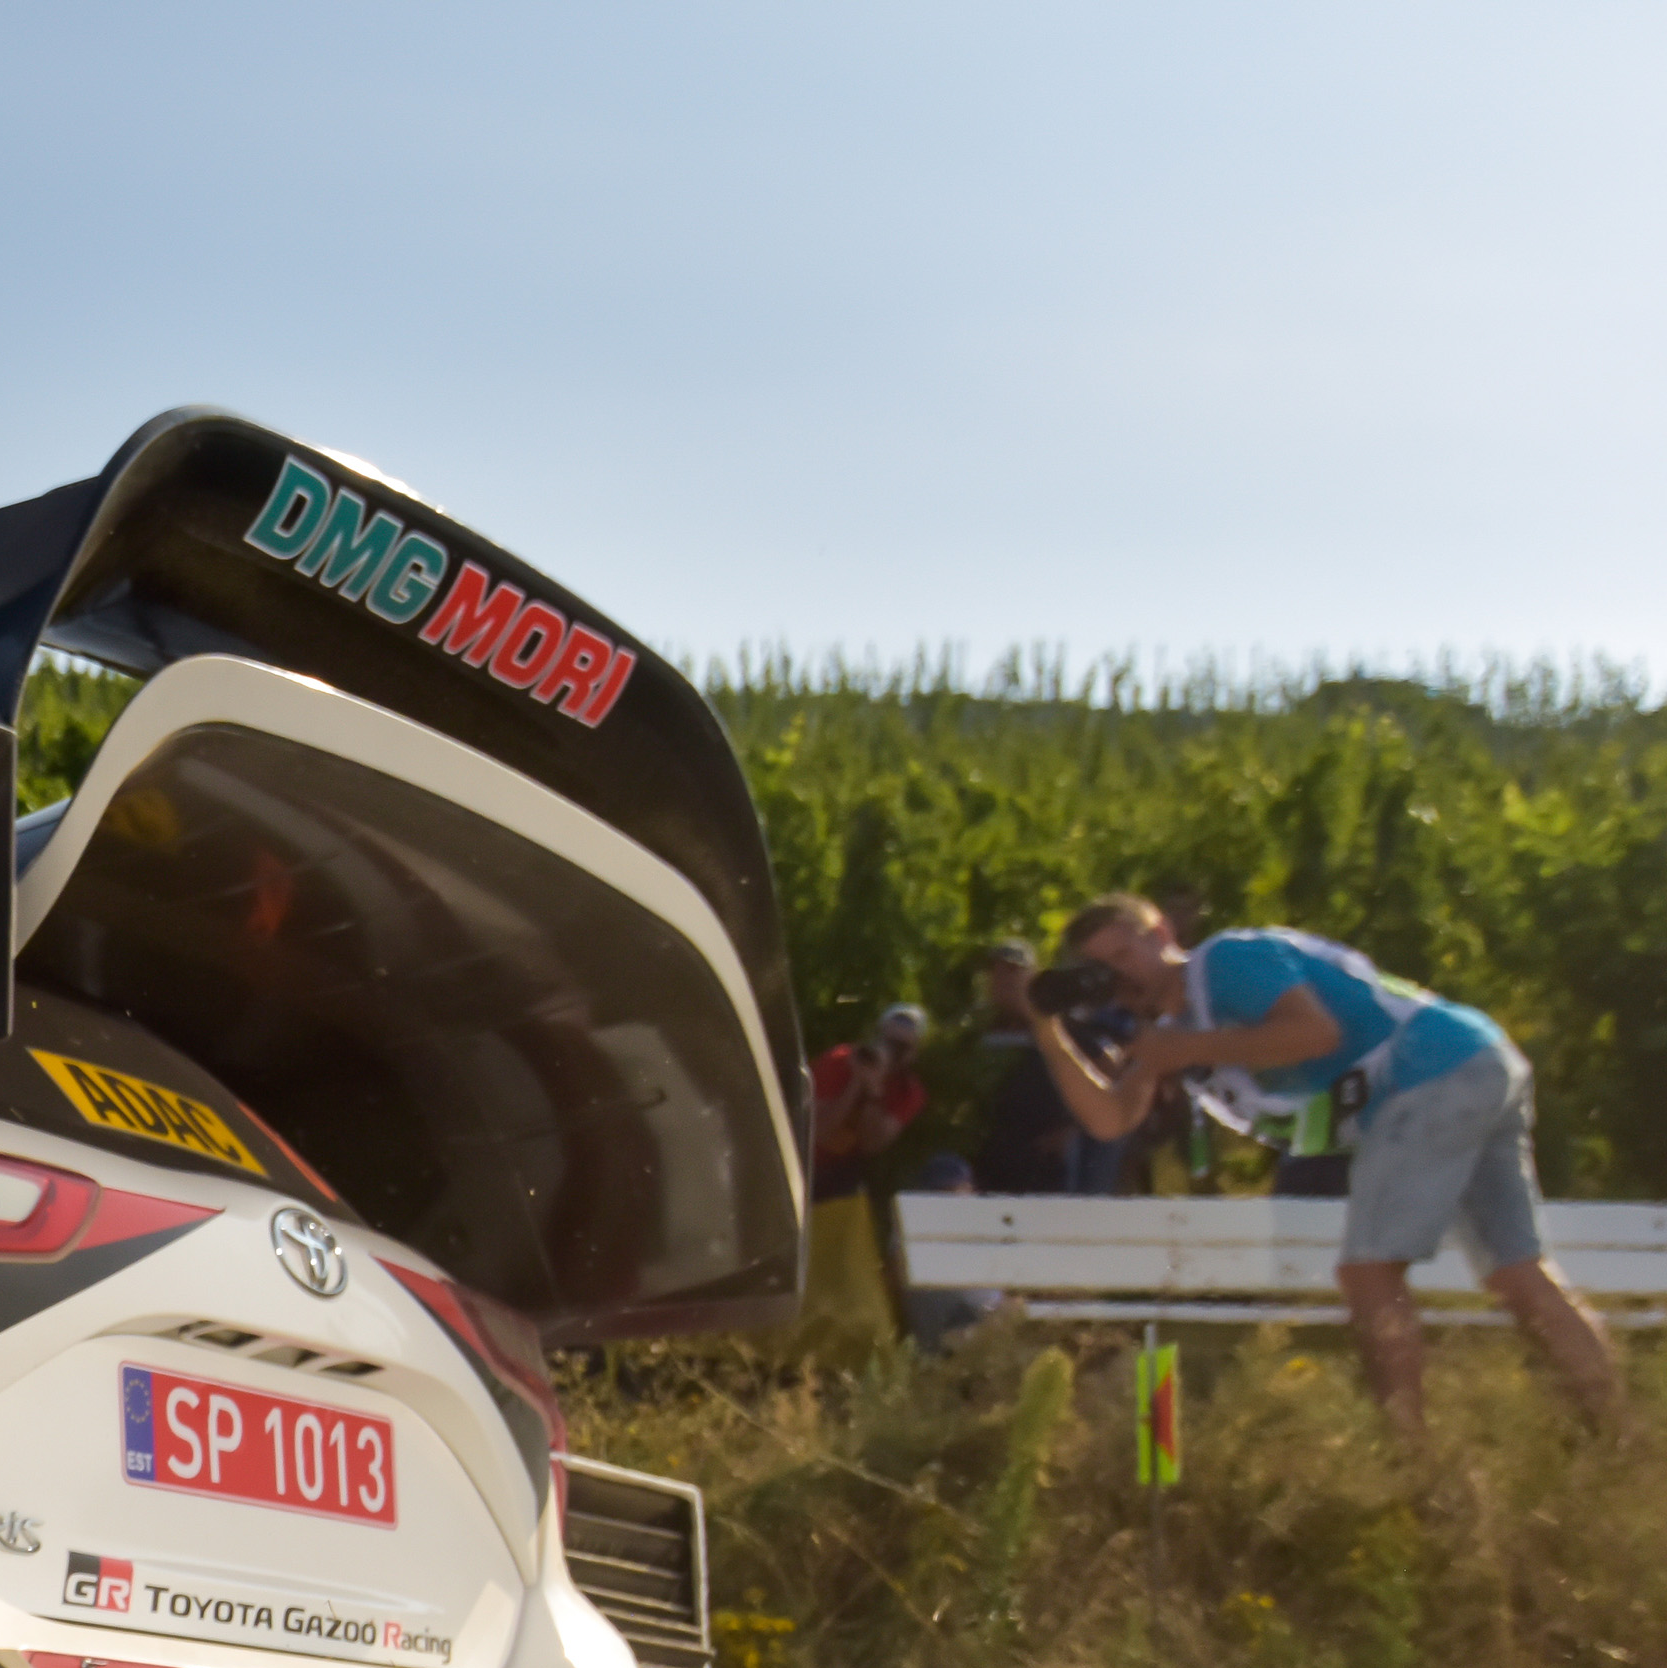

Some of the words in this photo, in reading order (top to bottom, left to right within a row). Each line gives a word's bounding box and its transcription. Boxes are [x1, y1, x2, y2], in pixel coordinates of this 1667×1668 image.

[243, 454, 448, 625] DMG
[417, 558, 637, 729] MORI
[62, 1062, 244, 1164] ADAC
[126, 1450, 153, 1473] EST
[165, 1386, 244, 1485] SP
[264, 1406, 387, 1513] 1013
[66, 1573, 130, 1613] GR
[383, 1620, 453, 1665] Racing
